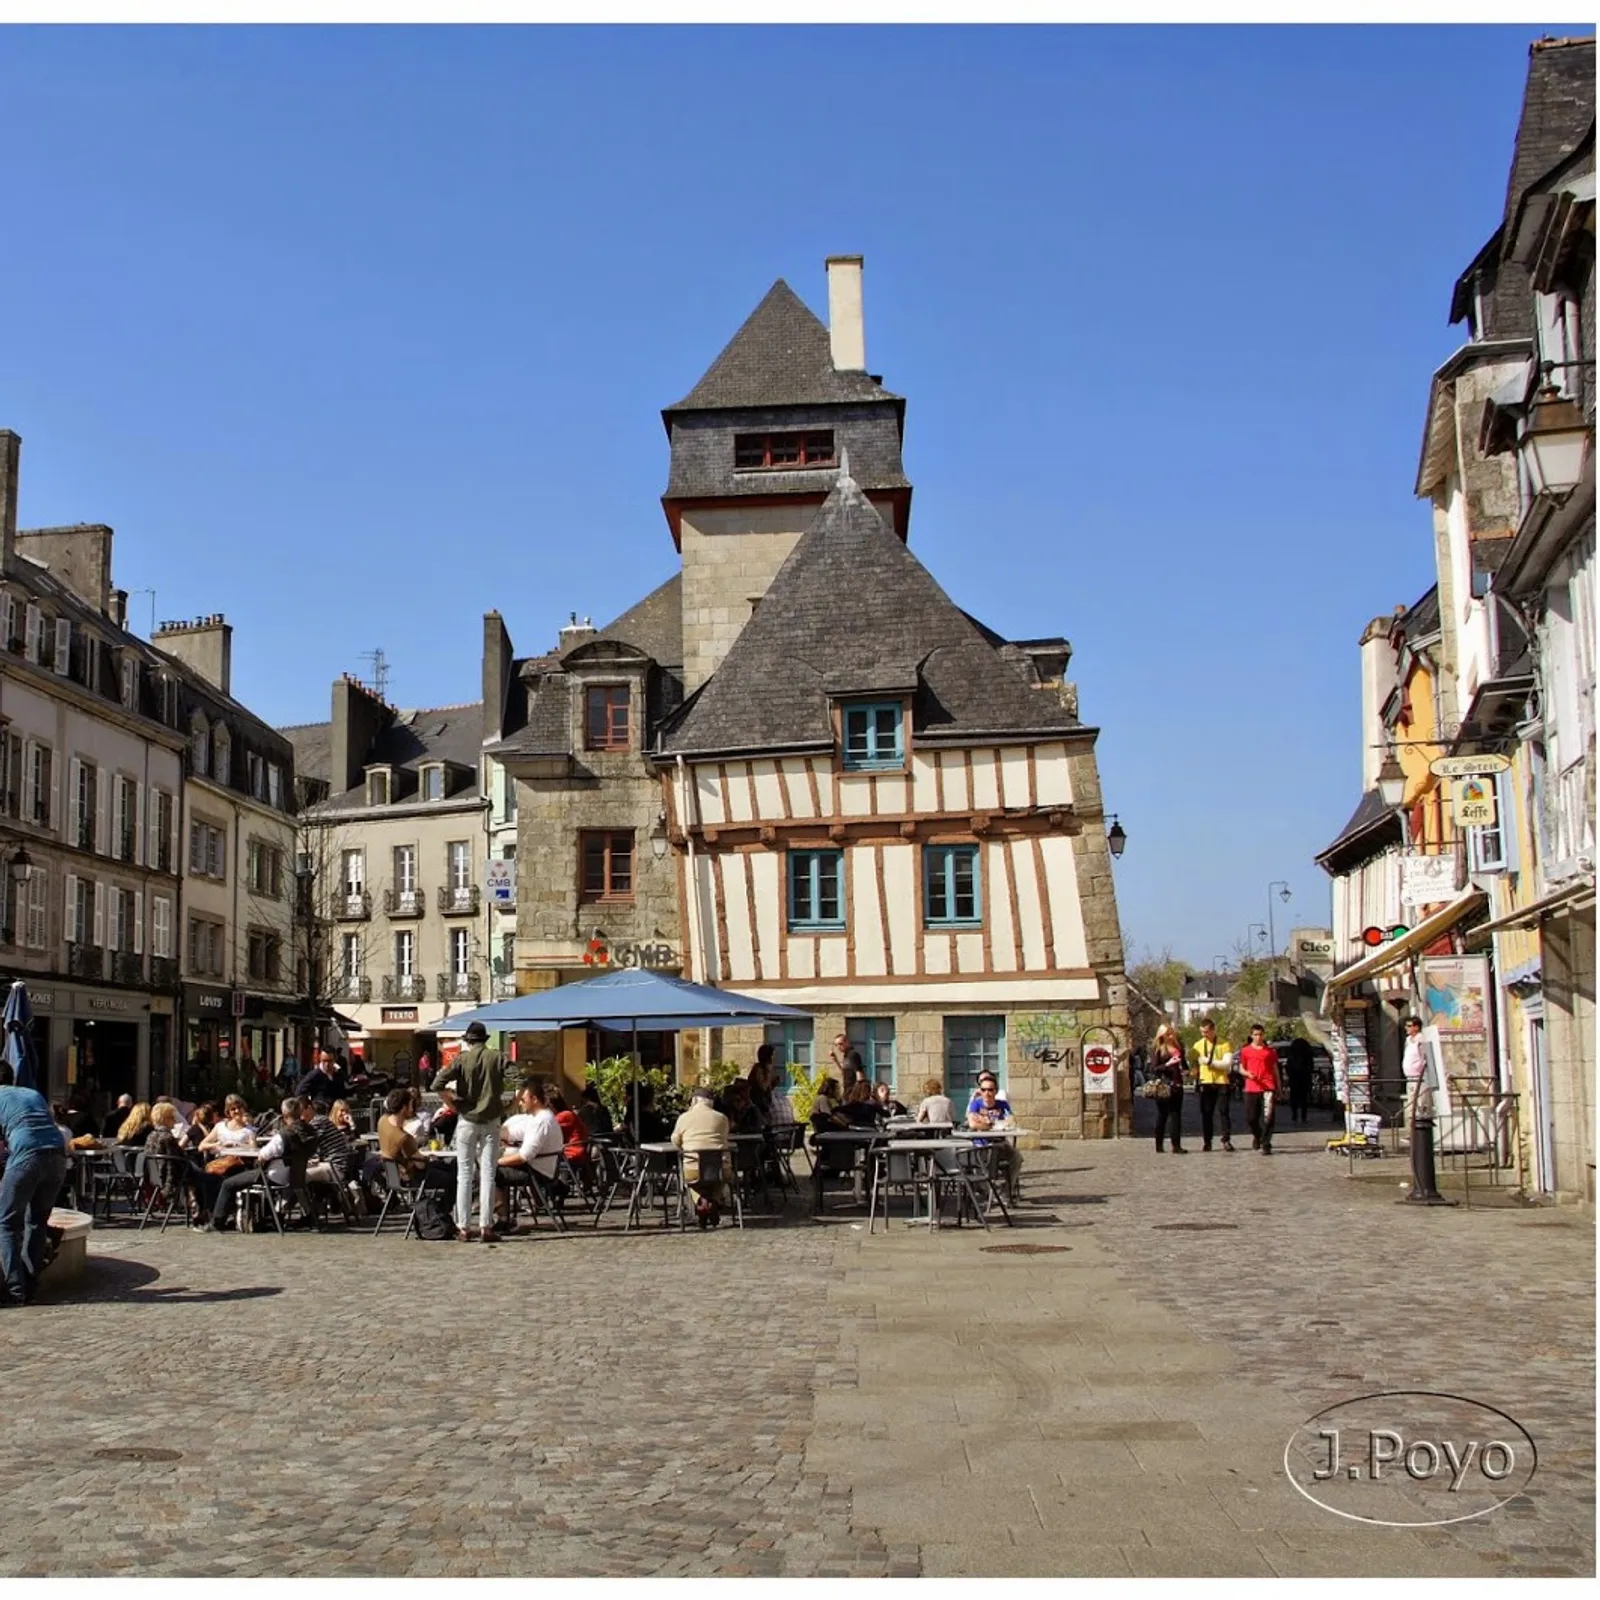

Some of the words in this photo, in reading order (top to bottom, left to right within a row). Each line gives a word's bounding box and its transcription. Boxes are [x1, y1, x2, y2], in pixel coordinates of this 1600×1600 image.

[1461, 805, 1488, 818] Leffe
[487, 878, 511, 887] CMB
[389, 1010, 415, 1020] TEXTO
